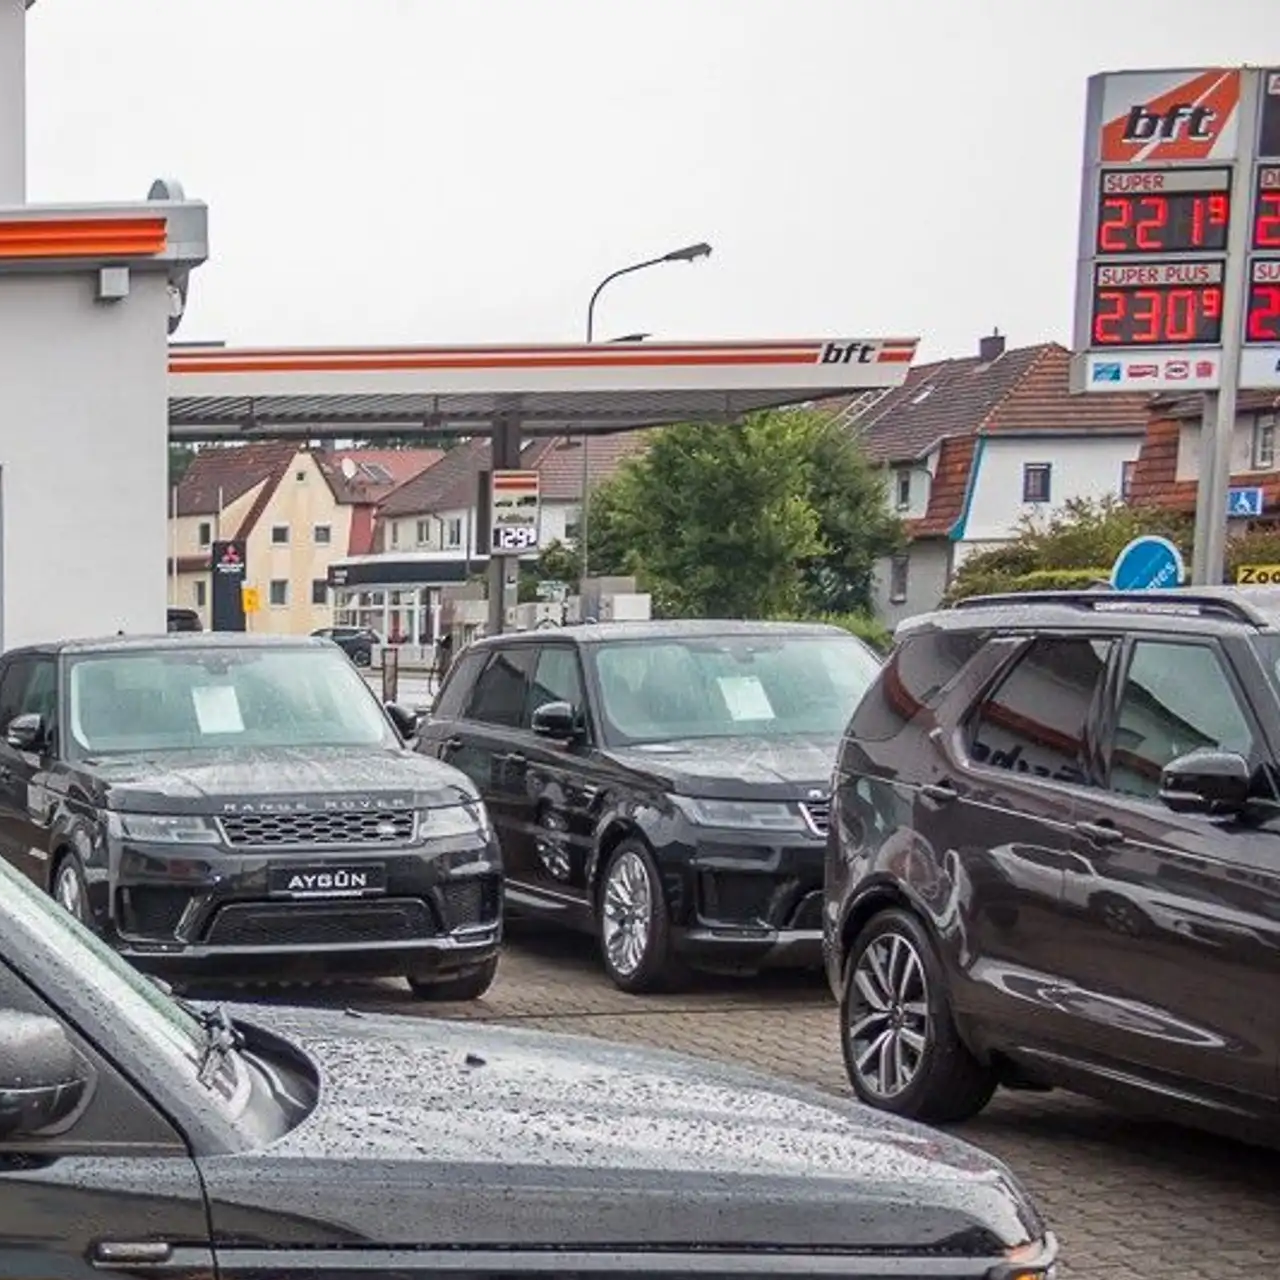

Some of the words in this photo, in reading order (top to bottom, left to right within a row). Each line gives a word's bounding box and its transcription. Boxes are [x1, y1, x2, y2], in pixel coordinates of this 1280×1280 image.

[1122, 103, 1217, 142] bft
[1106, 174, 1165, 191] SUPER
[1102, 268, 1159, 285] SUPER
[1165, 266, 1210, 282] PLUS
[821, 342, 876, 364] bft
[288, 870, 368, 889] AYGÜN
